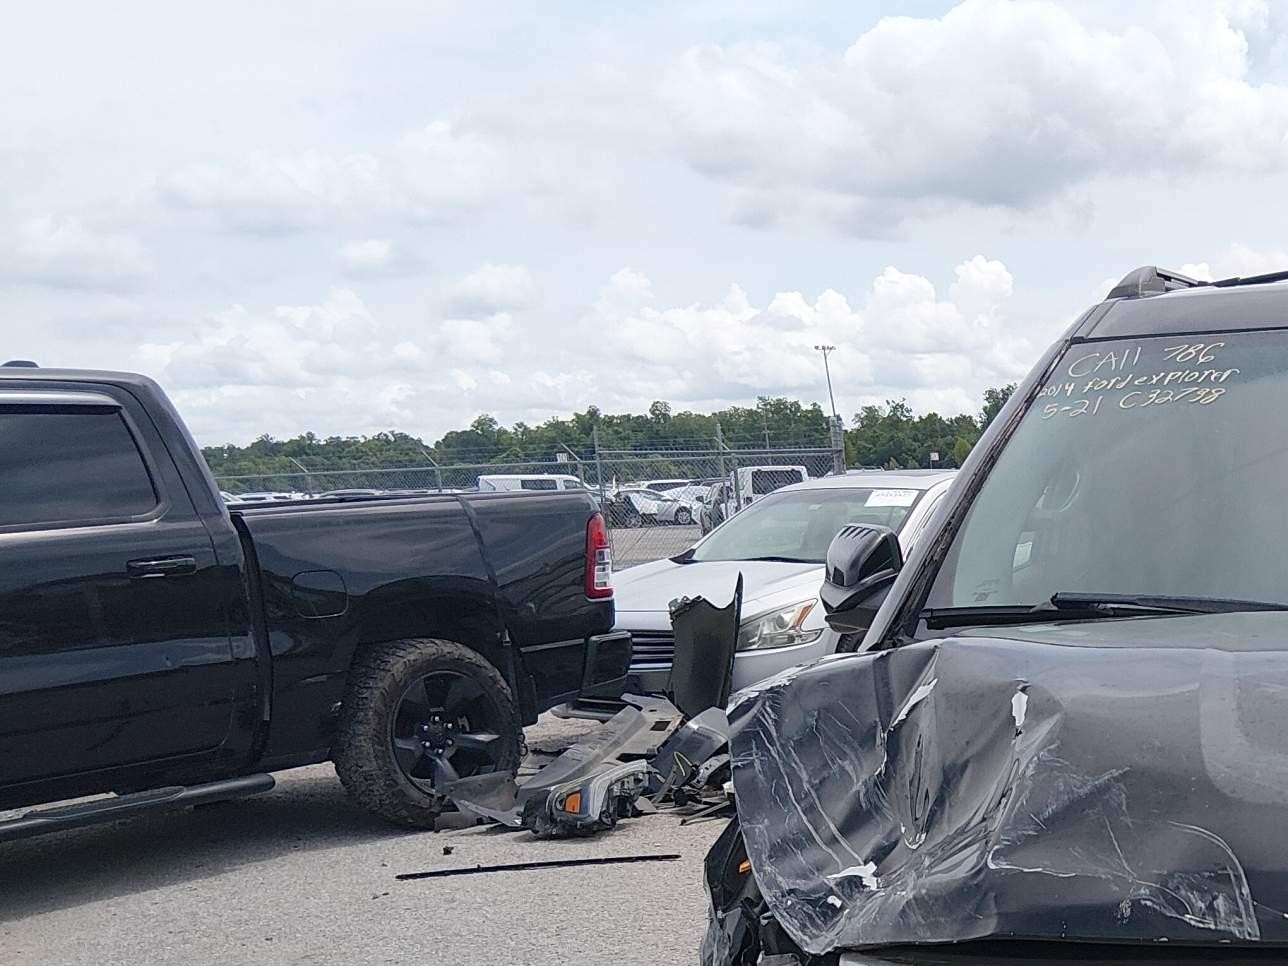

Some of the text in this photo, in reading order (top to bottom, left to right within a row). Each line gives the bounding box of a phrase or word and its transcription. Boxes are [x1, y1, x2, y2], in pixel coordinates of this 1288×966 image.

[1163, 342, 1225, 366] 786
[1036, 382, 1076, 398] 2014
[1041, 396, 1104, 419] 5-21
